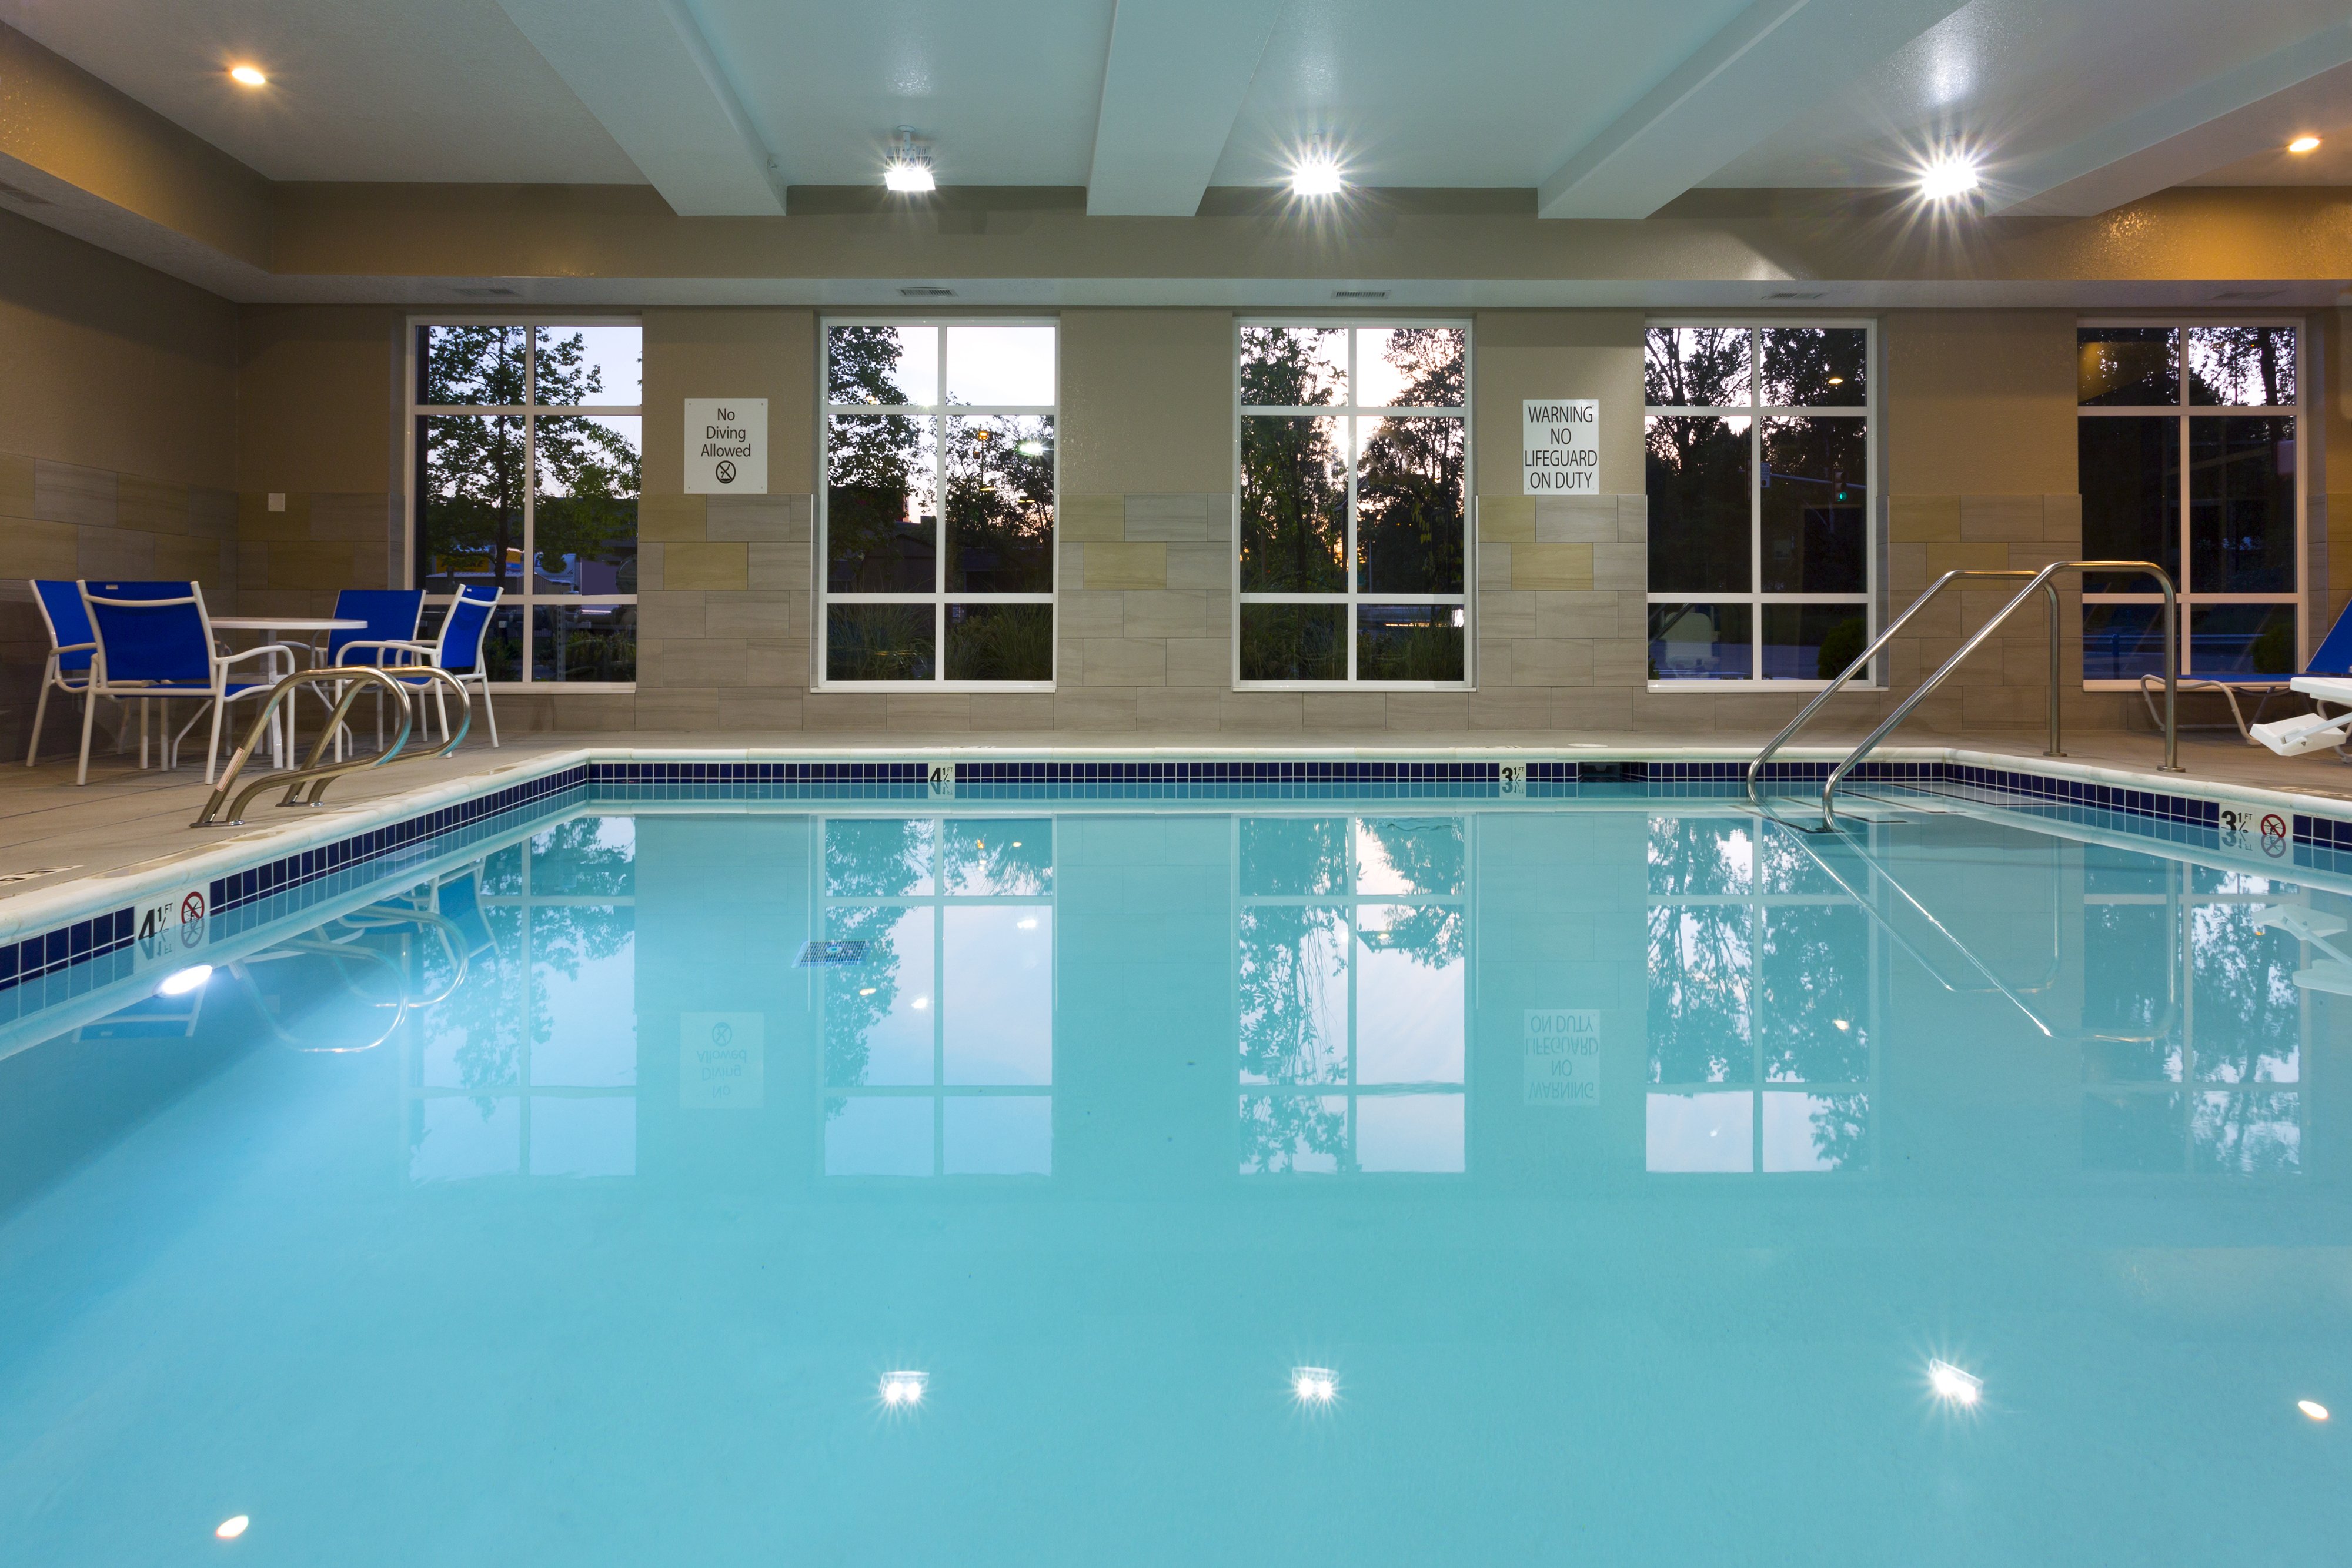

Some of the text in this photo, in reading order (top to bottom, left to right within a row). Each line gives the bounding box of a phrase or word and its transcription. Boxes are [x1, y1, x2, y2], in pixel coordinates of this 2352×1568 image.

[717, 408, 735, 421] No
[1528, 406, 1593, 423] WARNING
[706, 426, 746, 442] Diving
[1551, 428, 1571, 444] NO
[701, 443, 751, 457] Allowed
[1525, 450, 1598, 467] LIFEGUARD
[1530, 472, 1592, 489] ON DUTY
[165, 902, 173, 914] FT
